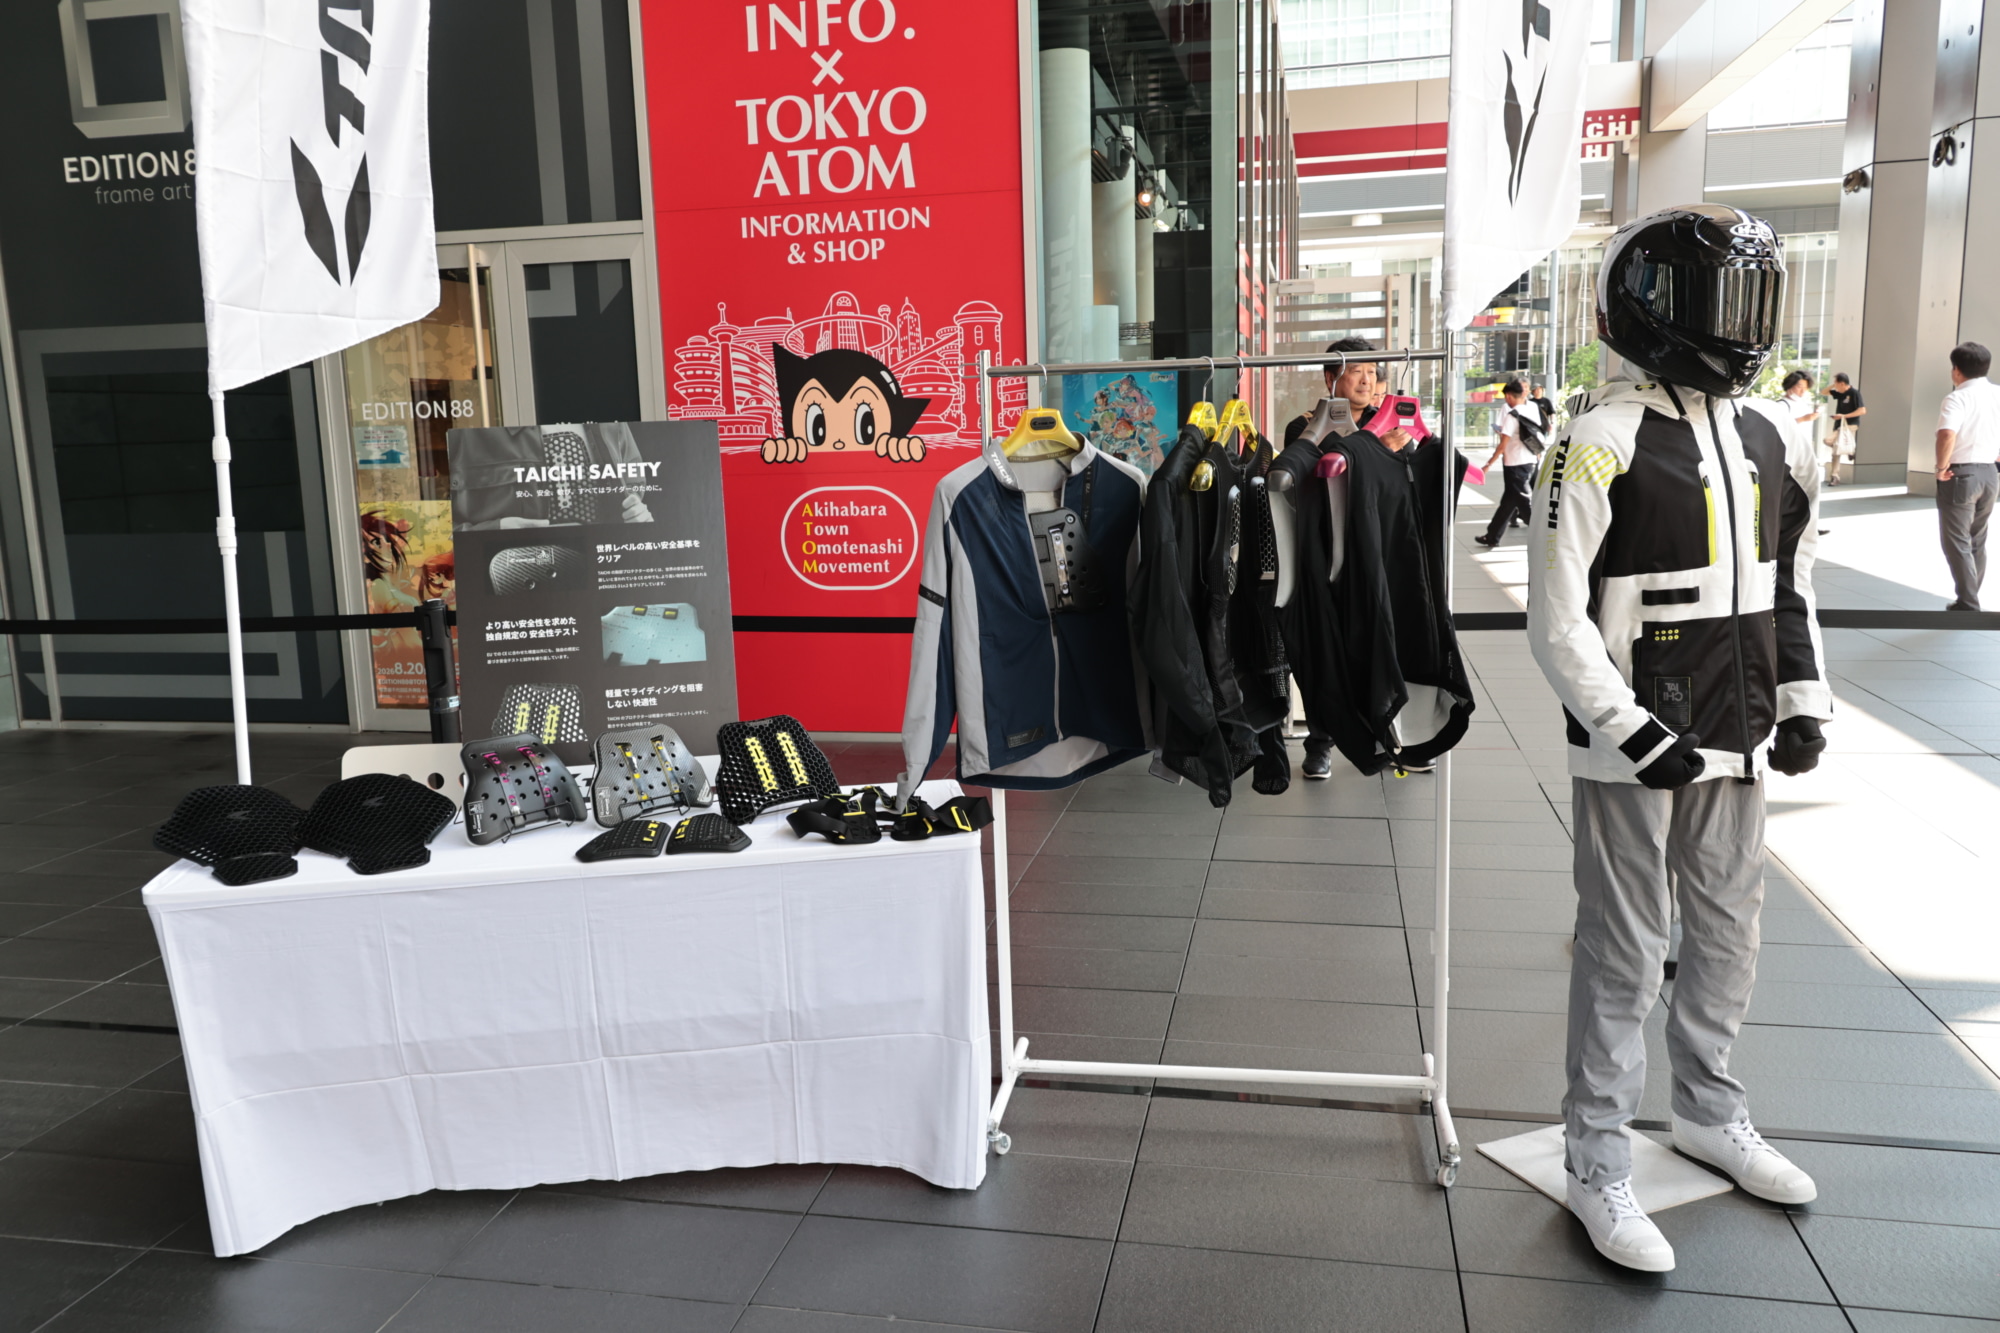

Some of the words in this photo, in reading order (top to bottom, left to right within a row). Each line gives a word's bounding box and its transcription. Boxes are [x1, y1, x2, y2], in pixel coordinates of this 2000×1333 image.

[746, 0, 915, 52] INFO.
[735, 86, 927, 145] TOKYO
[753, 142, 916, 198] ATOM
[95, 187, 154, 204] frame
[162, 183, 192, 200] art
[741, 206, 930, 239] INFORMATION
[787, 243, 806, 264] &
[813, 238, 885, 263] SHOP
[362, 399, 474, 420] EDITION88
[514, 464, 583, 483] TAICHI
[589, 461, 661, 480] SAFETY
[990, 452, 1014, 485] TAICHI
[1547, 434, 1571, 529] TAICHI
[802, 501, 887, 517] Akihabara
[803, 522, 849, 536] Town
[596, 539, 700, 553] 世界レベルの高い安全基準を
[802, 538, 902, 555] Omotenashi
[1546, 530, 1557, 570] TECH
[597, 554, 621, 564] クリア
[803, 559, 890, 574] Movement
[485, 617, 576, 630] より高い安全性を求めた
[529, 627, 578, 639] 安全性テスト
[605, 683, 703, 698] 軽量でライディングを阻害
[607, 700, 631, 709] しない
[632, 697, 657, 707] 快適性
